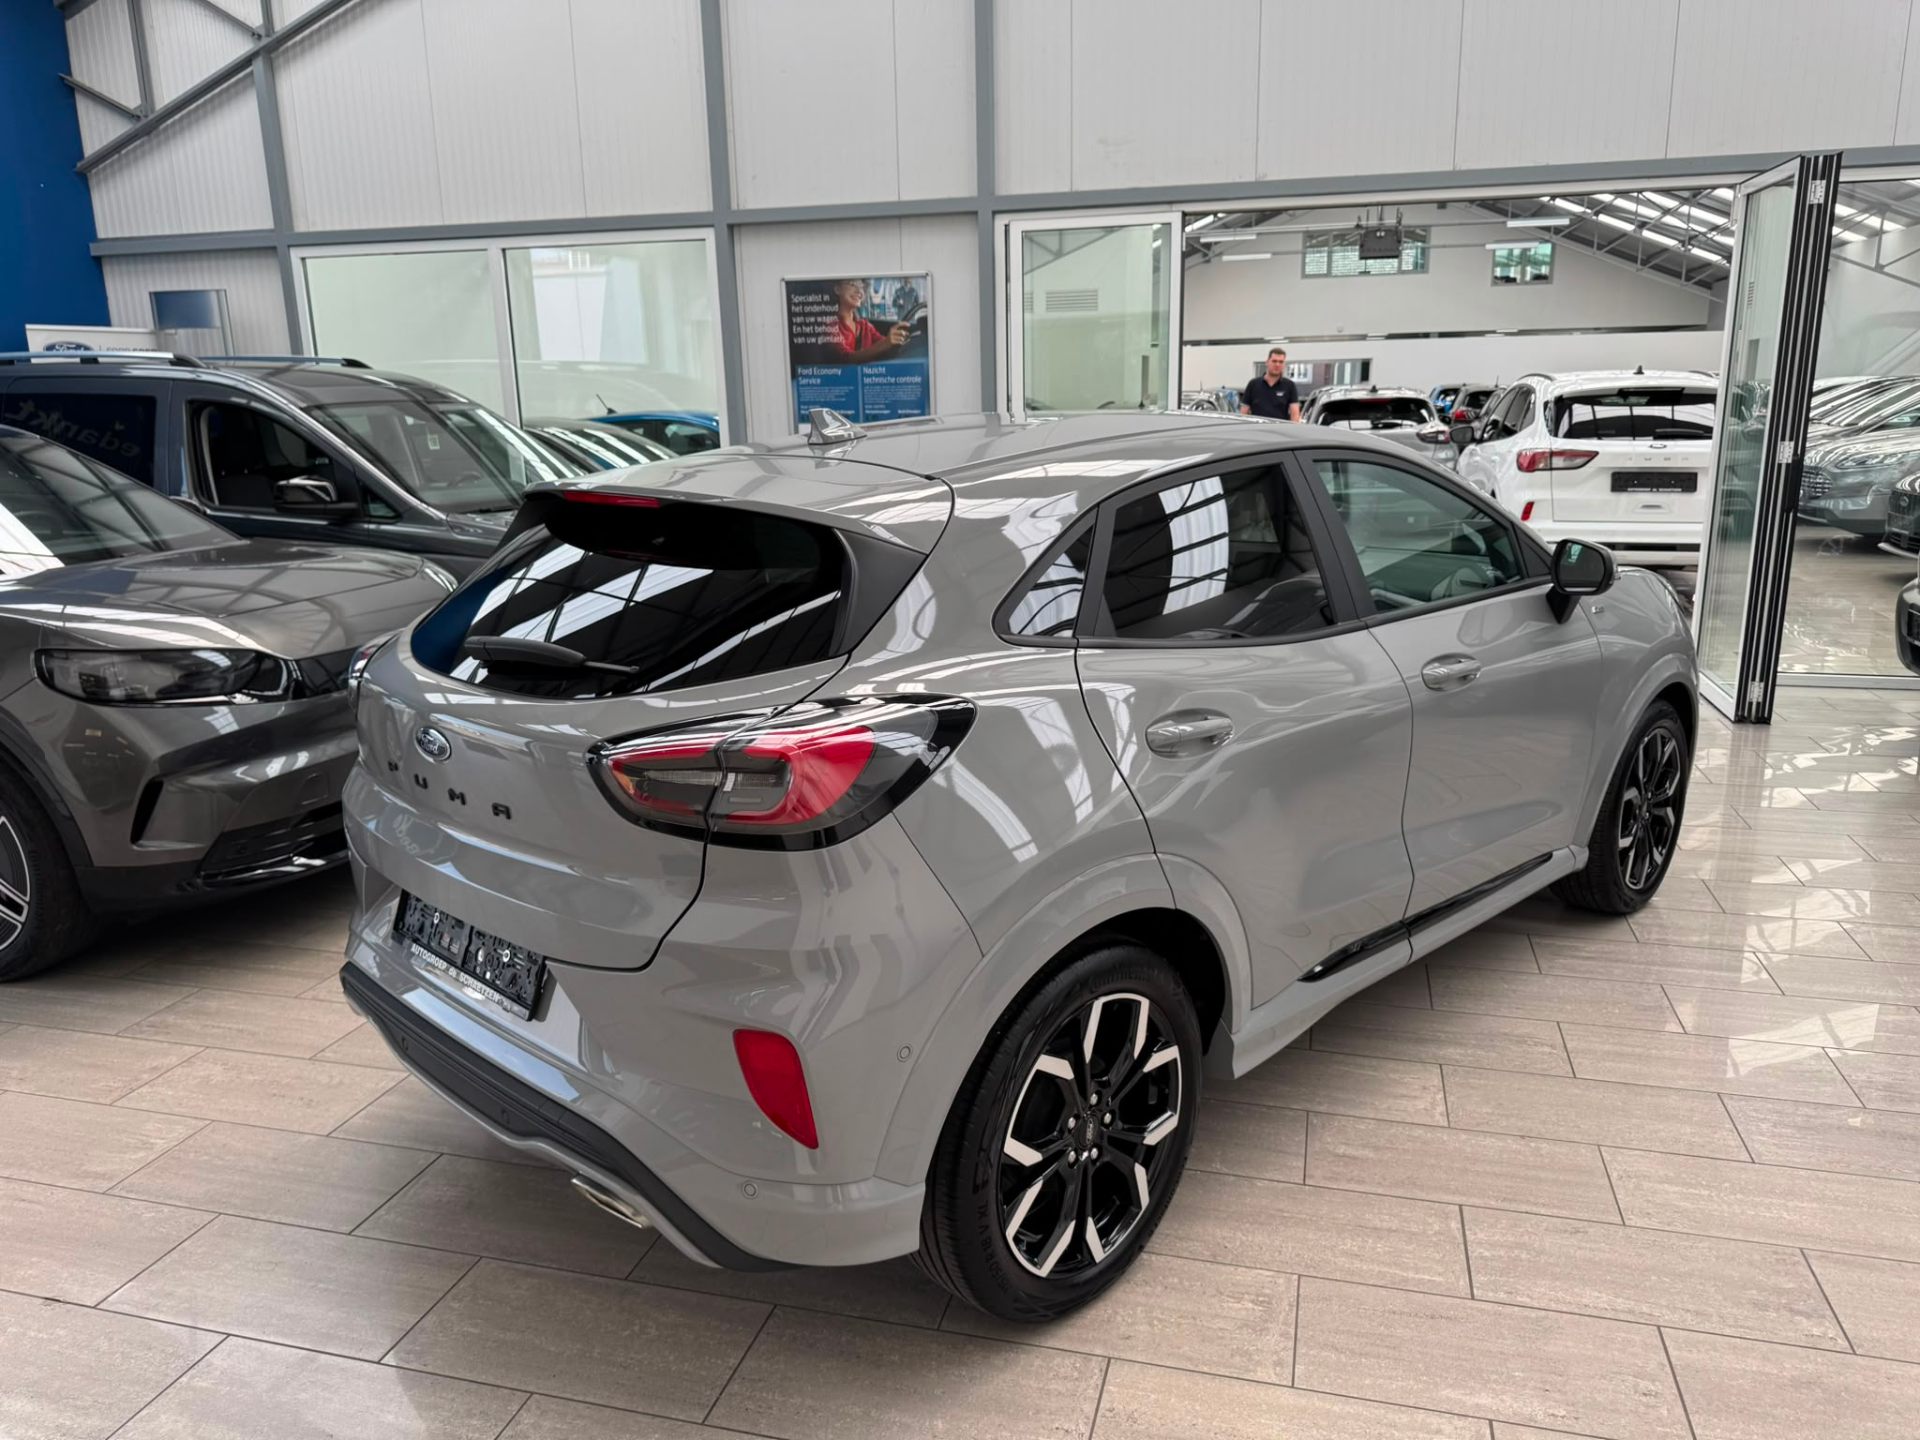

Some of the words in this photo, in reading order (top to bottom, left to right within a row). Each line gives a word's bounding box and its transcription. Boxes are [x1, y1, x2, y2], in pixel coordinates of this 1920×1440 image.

[791, 294, 822, 303] Specialist
[823, 294, 830, 302] in
[791, 304, 804, 313] het
[804, 303, 839, 313] onderhoud
[792, 316, 805, 324] van
[805, 316, 816, 324] uw
[793, 326, 802, 334] En
[803, 326, 814, 334] het
[815, 325, 840, 334] behoud
[793, 336, 807, 344] van
[808, 336, 817, 344] uw
[798, 367, 812, 375] Ford
[813, 367, 841, 376] Economy
[863, 366, 886, 374] Nazicht
[798, 377, 821, 385] Service
[863, 376, 895, 384] technische
[896, 376, 922, 384] controle
[387, 760, 511, 820] PUMA
[411, 943, 447, 970] AUTOGROEP
